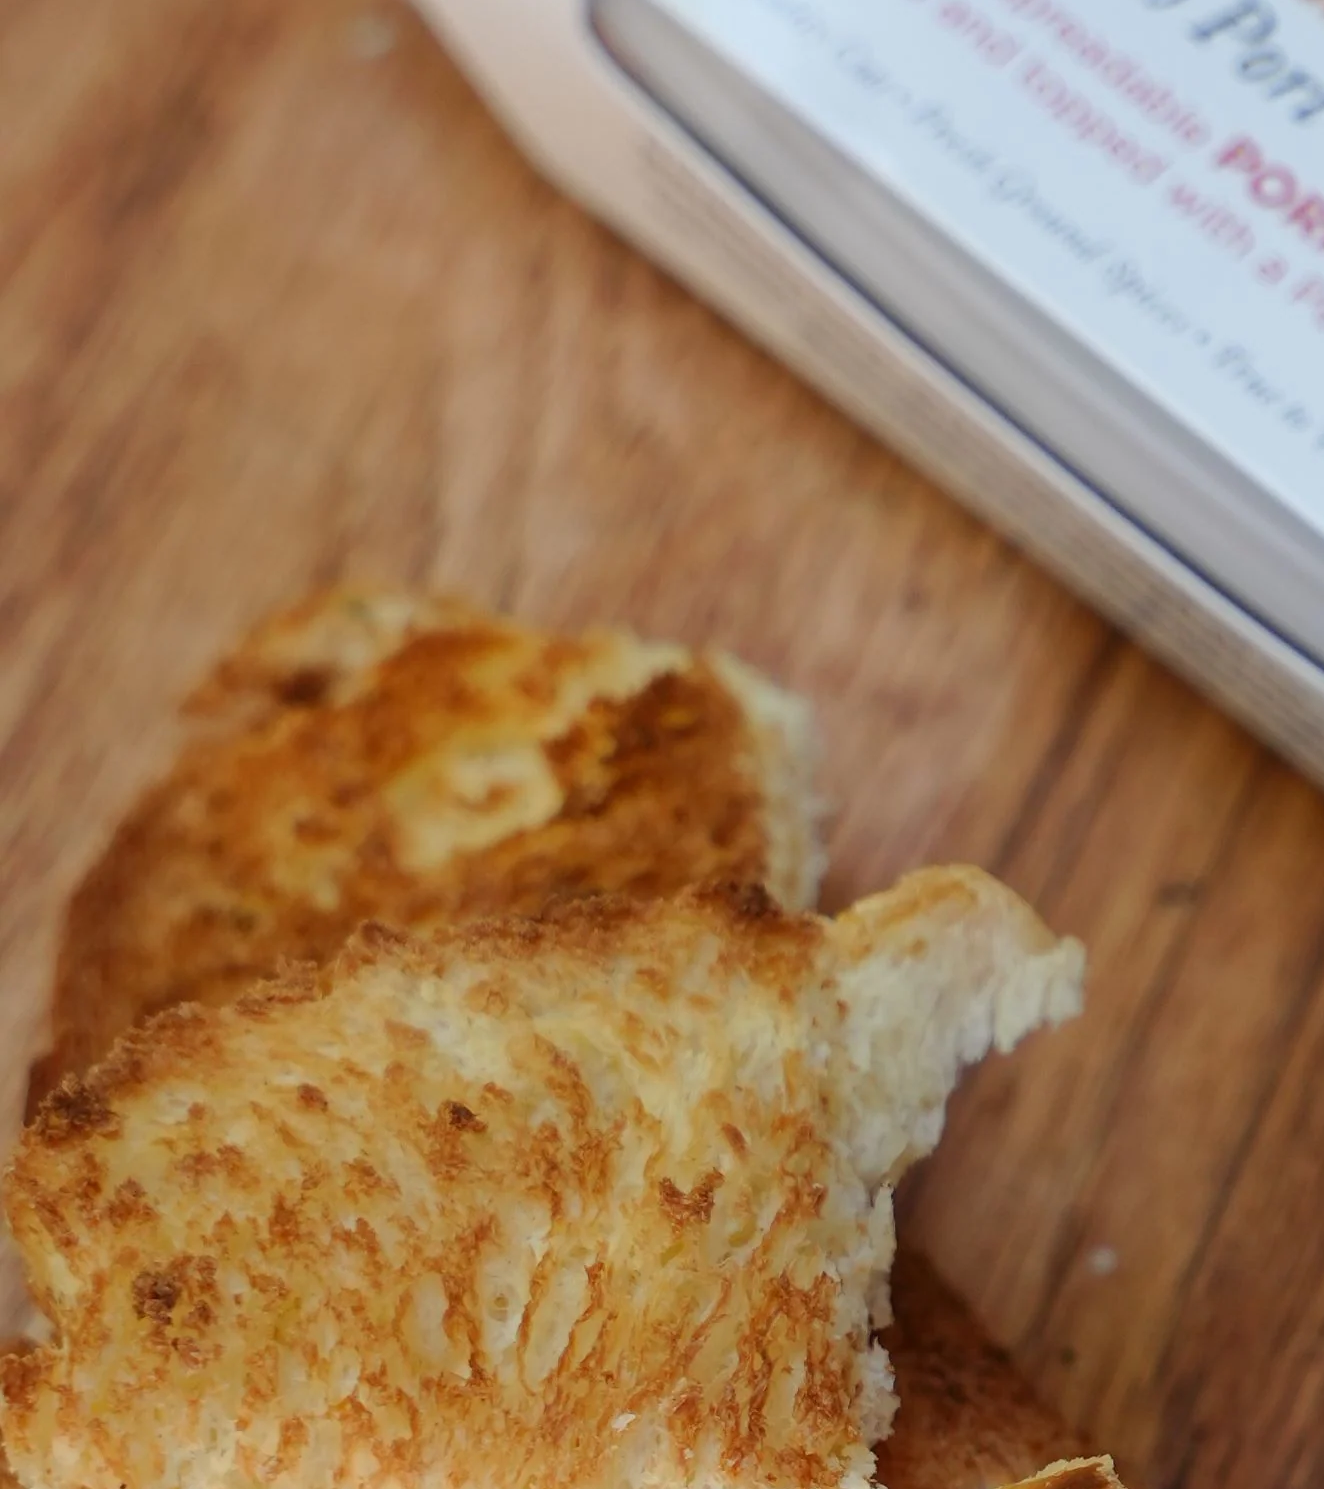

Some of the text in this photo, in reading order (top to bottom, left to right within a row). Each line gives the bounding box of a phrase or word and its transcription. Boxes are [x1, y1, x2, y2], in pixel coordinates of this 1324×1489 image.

[938, 1, 1022, 78] and
[1022, 61, 1168, 193] topped
[1169, 184, 1264, 256] with
[1258, 246, 1296, 283] a
